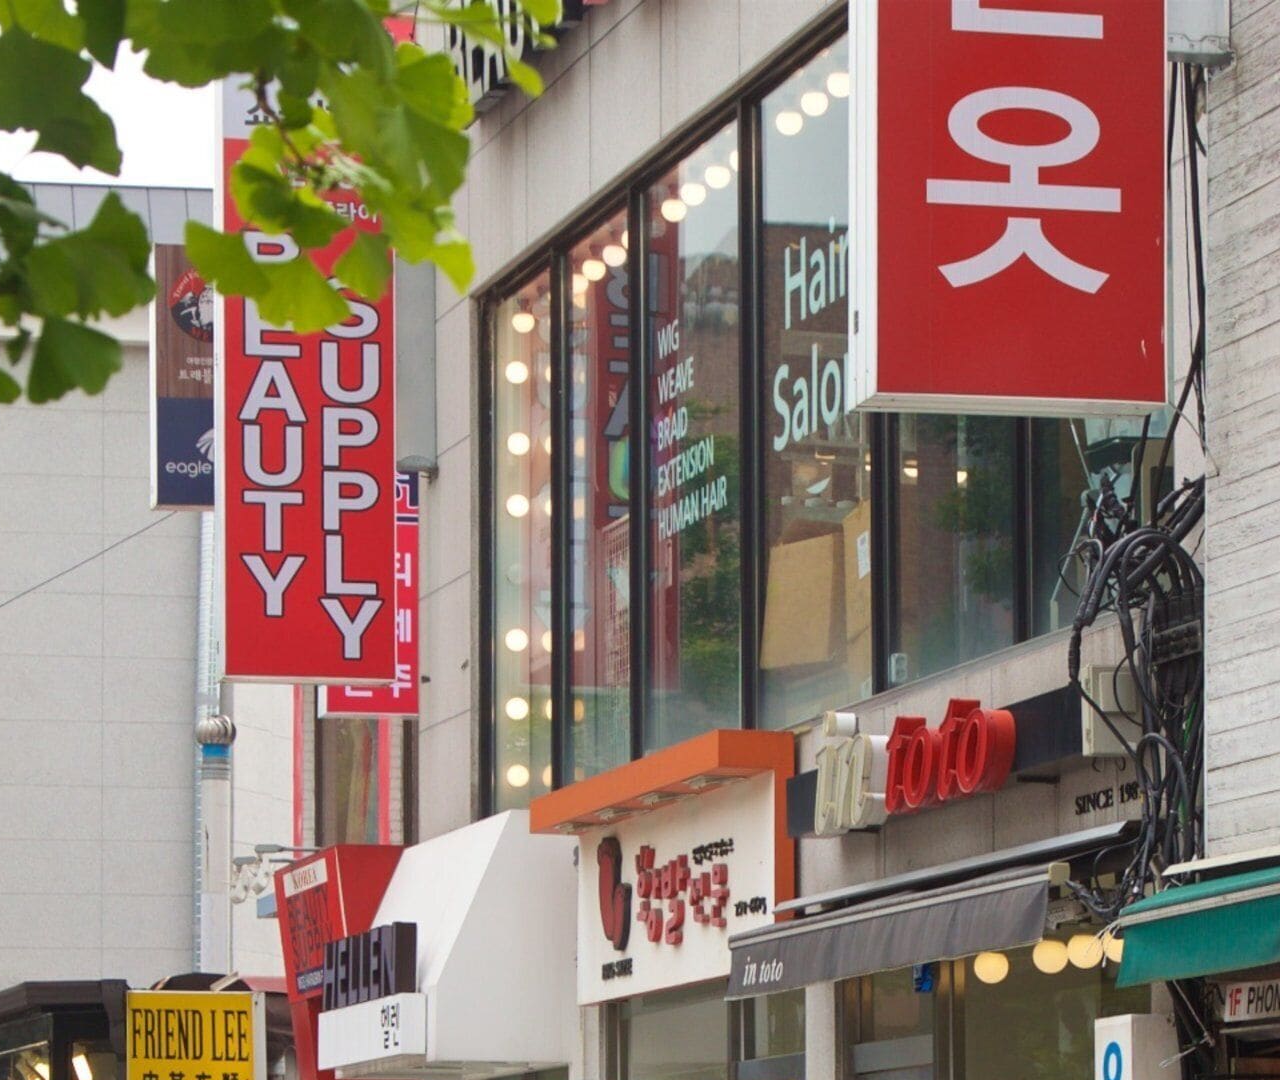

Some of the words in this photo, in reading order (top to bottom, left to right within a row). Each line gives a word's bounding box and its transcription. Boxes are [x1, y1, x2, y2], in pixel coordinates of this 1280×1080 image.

[658, 319, 680, 359] WIG
[658, 356, 694, 404] WEAVE
[658, 407, 687, 452] BRAID
[166, 459, 211, 478] eagle
[658, 435, 714, 498] EXTENSION
[658, 491, 699, 541] HUMAN
[700, 476, 727, 519] HAIR
[815, 711, 889, 836] in
[884, 698, 1016, 816] toto
[1073, 787, 1114, 816] SINCE
[322, 922, 398, 1012] HELLEN
[743, 954, 756, 987] in
[759, 957, 784, 985] toto
[1229, 987, 1242, 1016] 1F
[131, 1008, 203, 1060] FRIEND
[212, 1010, 250, 1062] LEE
